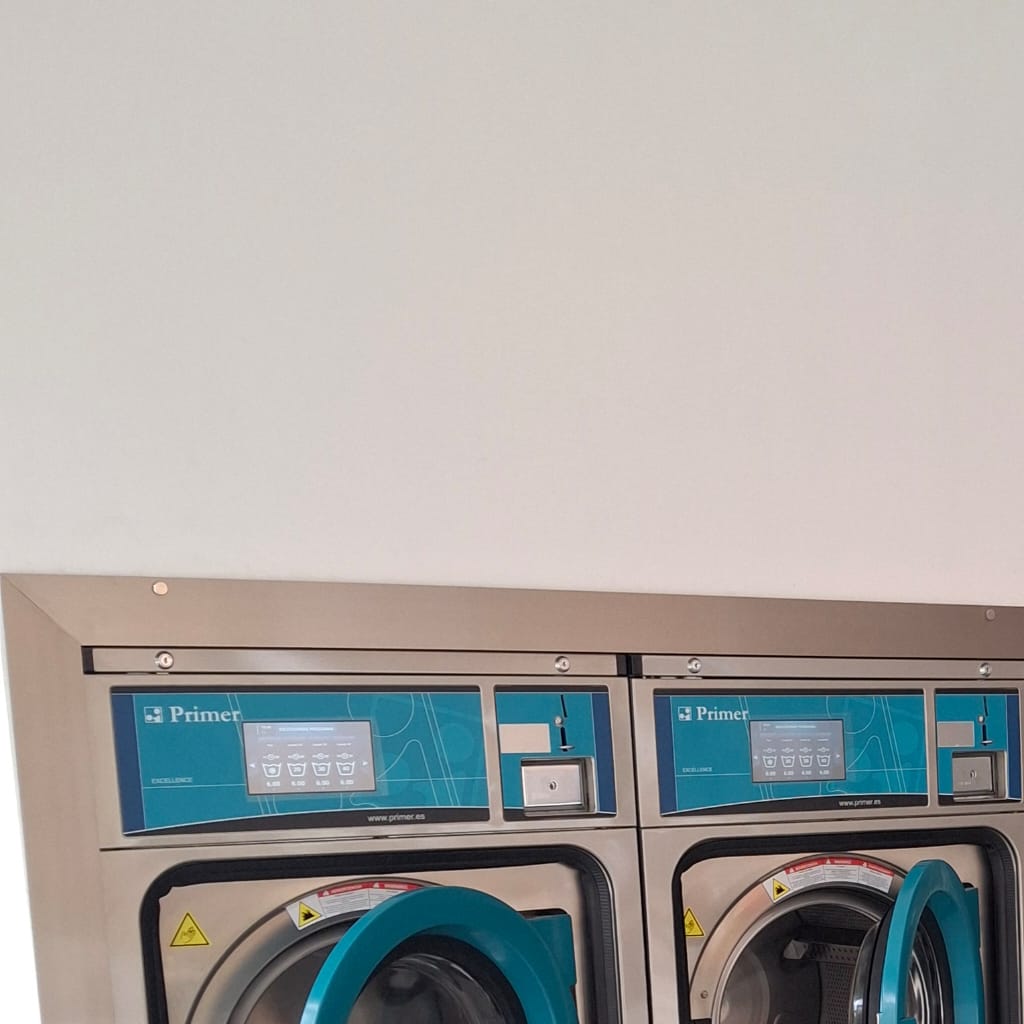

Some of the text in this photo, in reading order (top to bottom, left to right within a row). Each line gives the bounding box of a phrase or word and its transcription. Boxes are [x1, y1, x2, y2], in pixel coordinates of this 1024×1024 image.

[167, 705, 241, 723] Primer
[695, 705, 749, 721] Primer
[366, 812, 426, 823] www.primer.es
